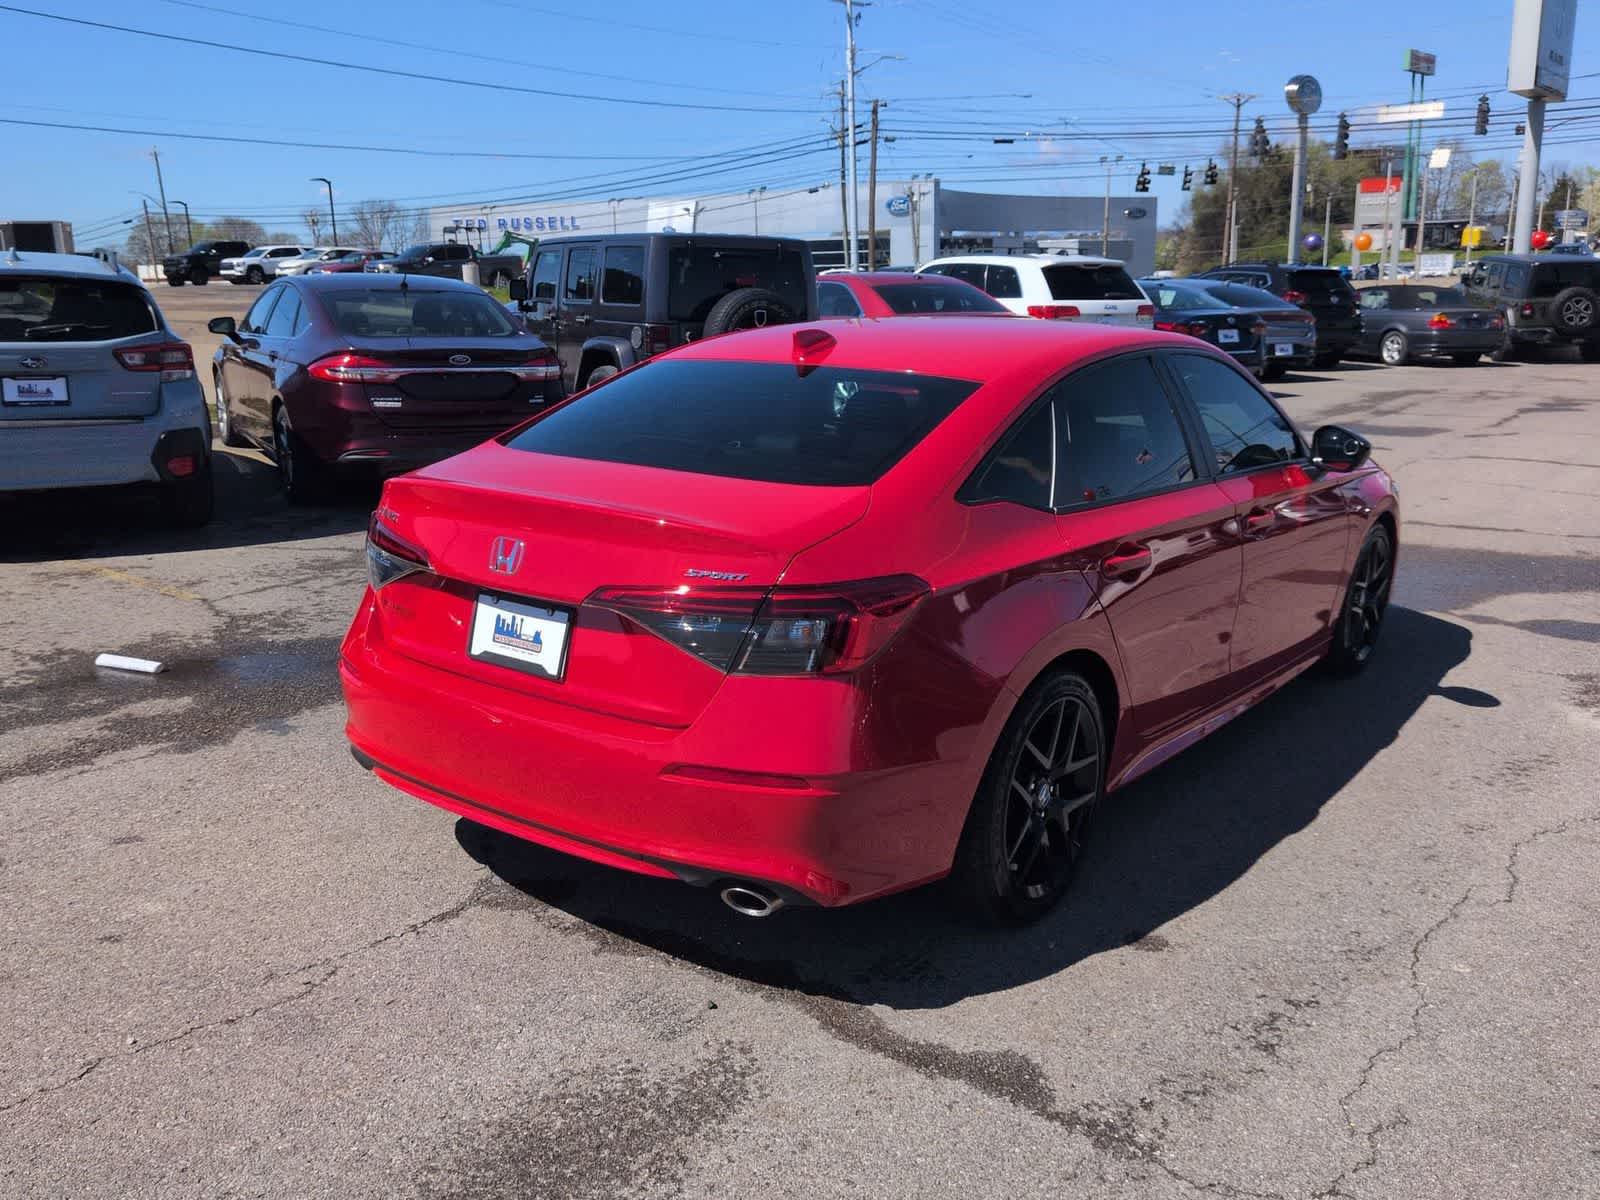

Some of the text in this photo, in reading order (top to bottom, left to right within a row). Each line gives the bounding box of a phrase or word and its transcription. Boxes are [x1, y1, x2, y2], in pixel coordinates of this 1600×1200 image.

[453, 215, 580, 232] TED RUSSELL
[685, 568, 748, 581] SPORT
